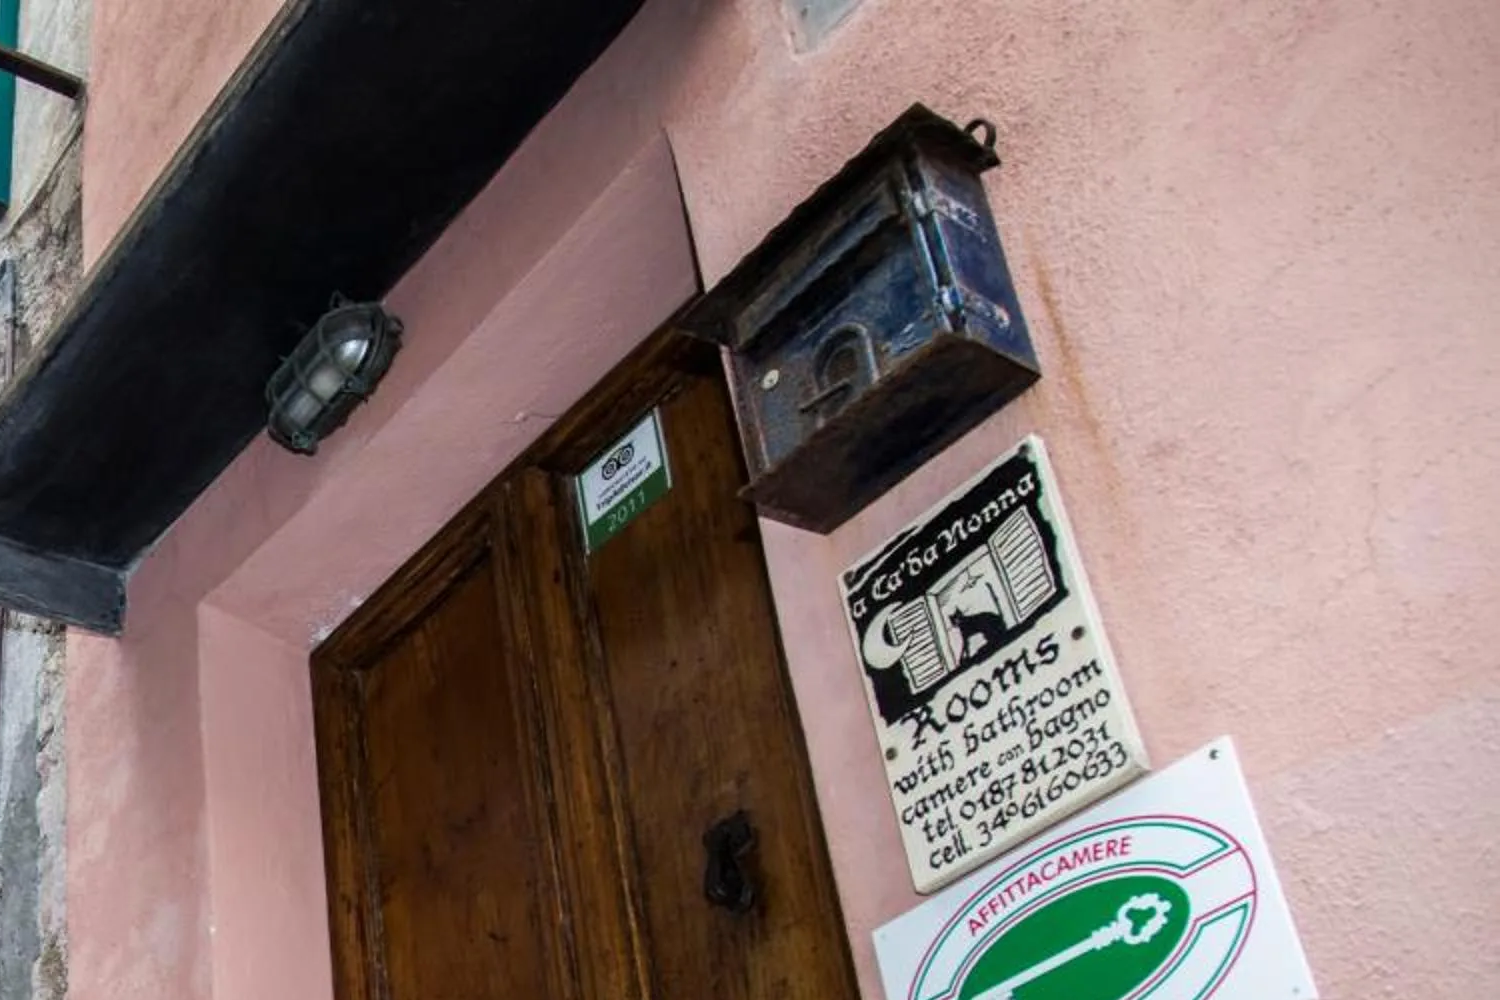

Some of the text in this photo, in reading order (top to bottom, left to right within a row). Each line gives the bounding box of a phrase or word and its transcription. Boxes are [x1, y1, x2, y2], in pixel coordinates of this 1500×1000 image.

[606, 490, 646, 533] 2011
[937, 472, 1036, 553] Nonna
[893, 657, 1103, 796] with bathroom
[900, 632, 1060, 750] Rooms
[901, 687, 1113, 826] camere con bagno
[927, 830, 973, 871] cell.
[966, 834, 1133, 938] AFFITTACAMERE
